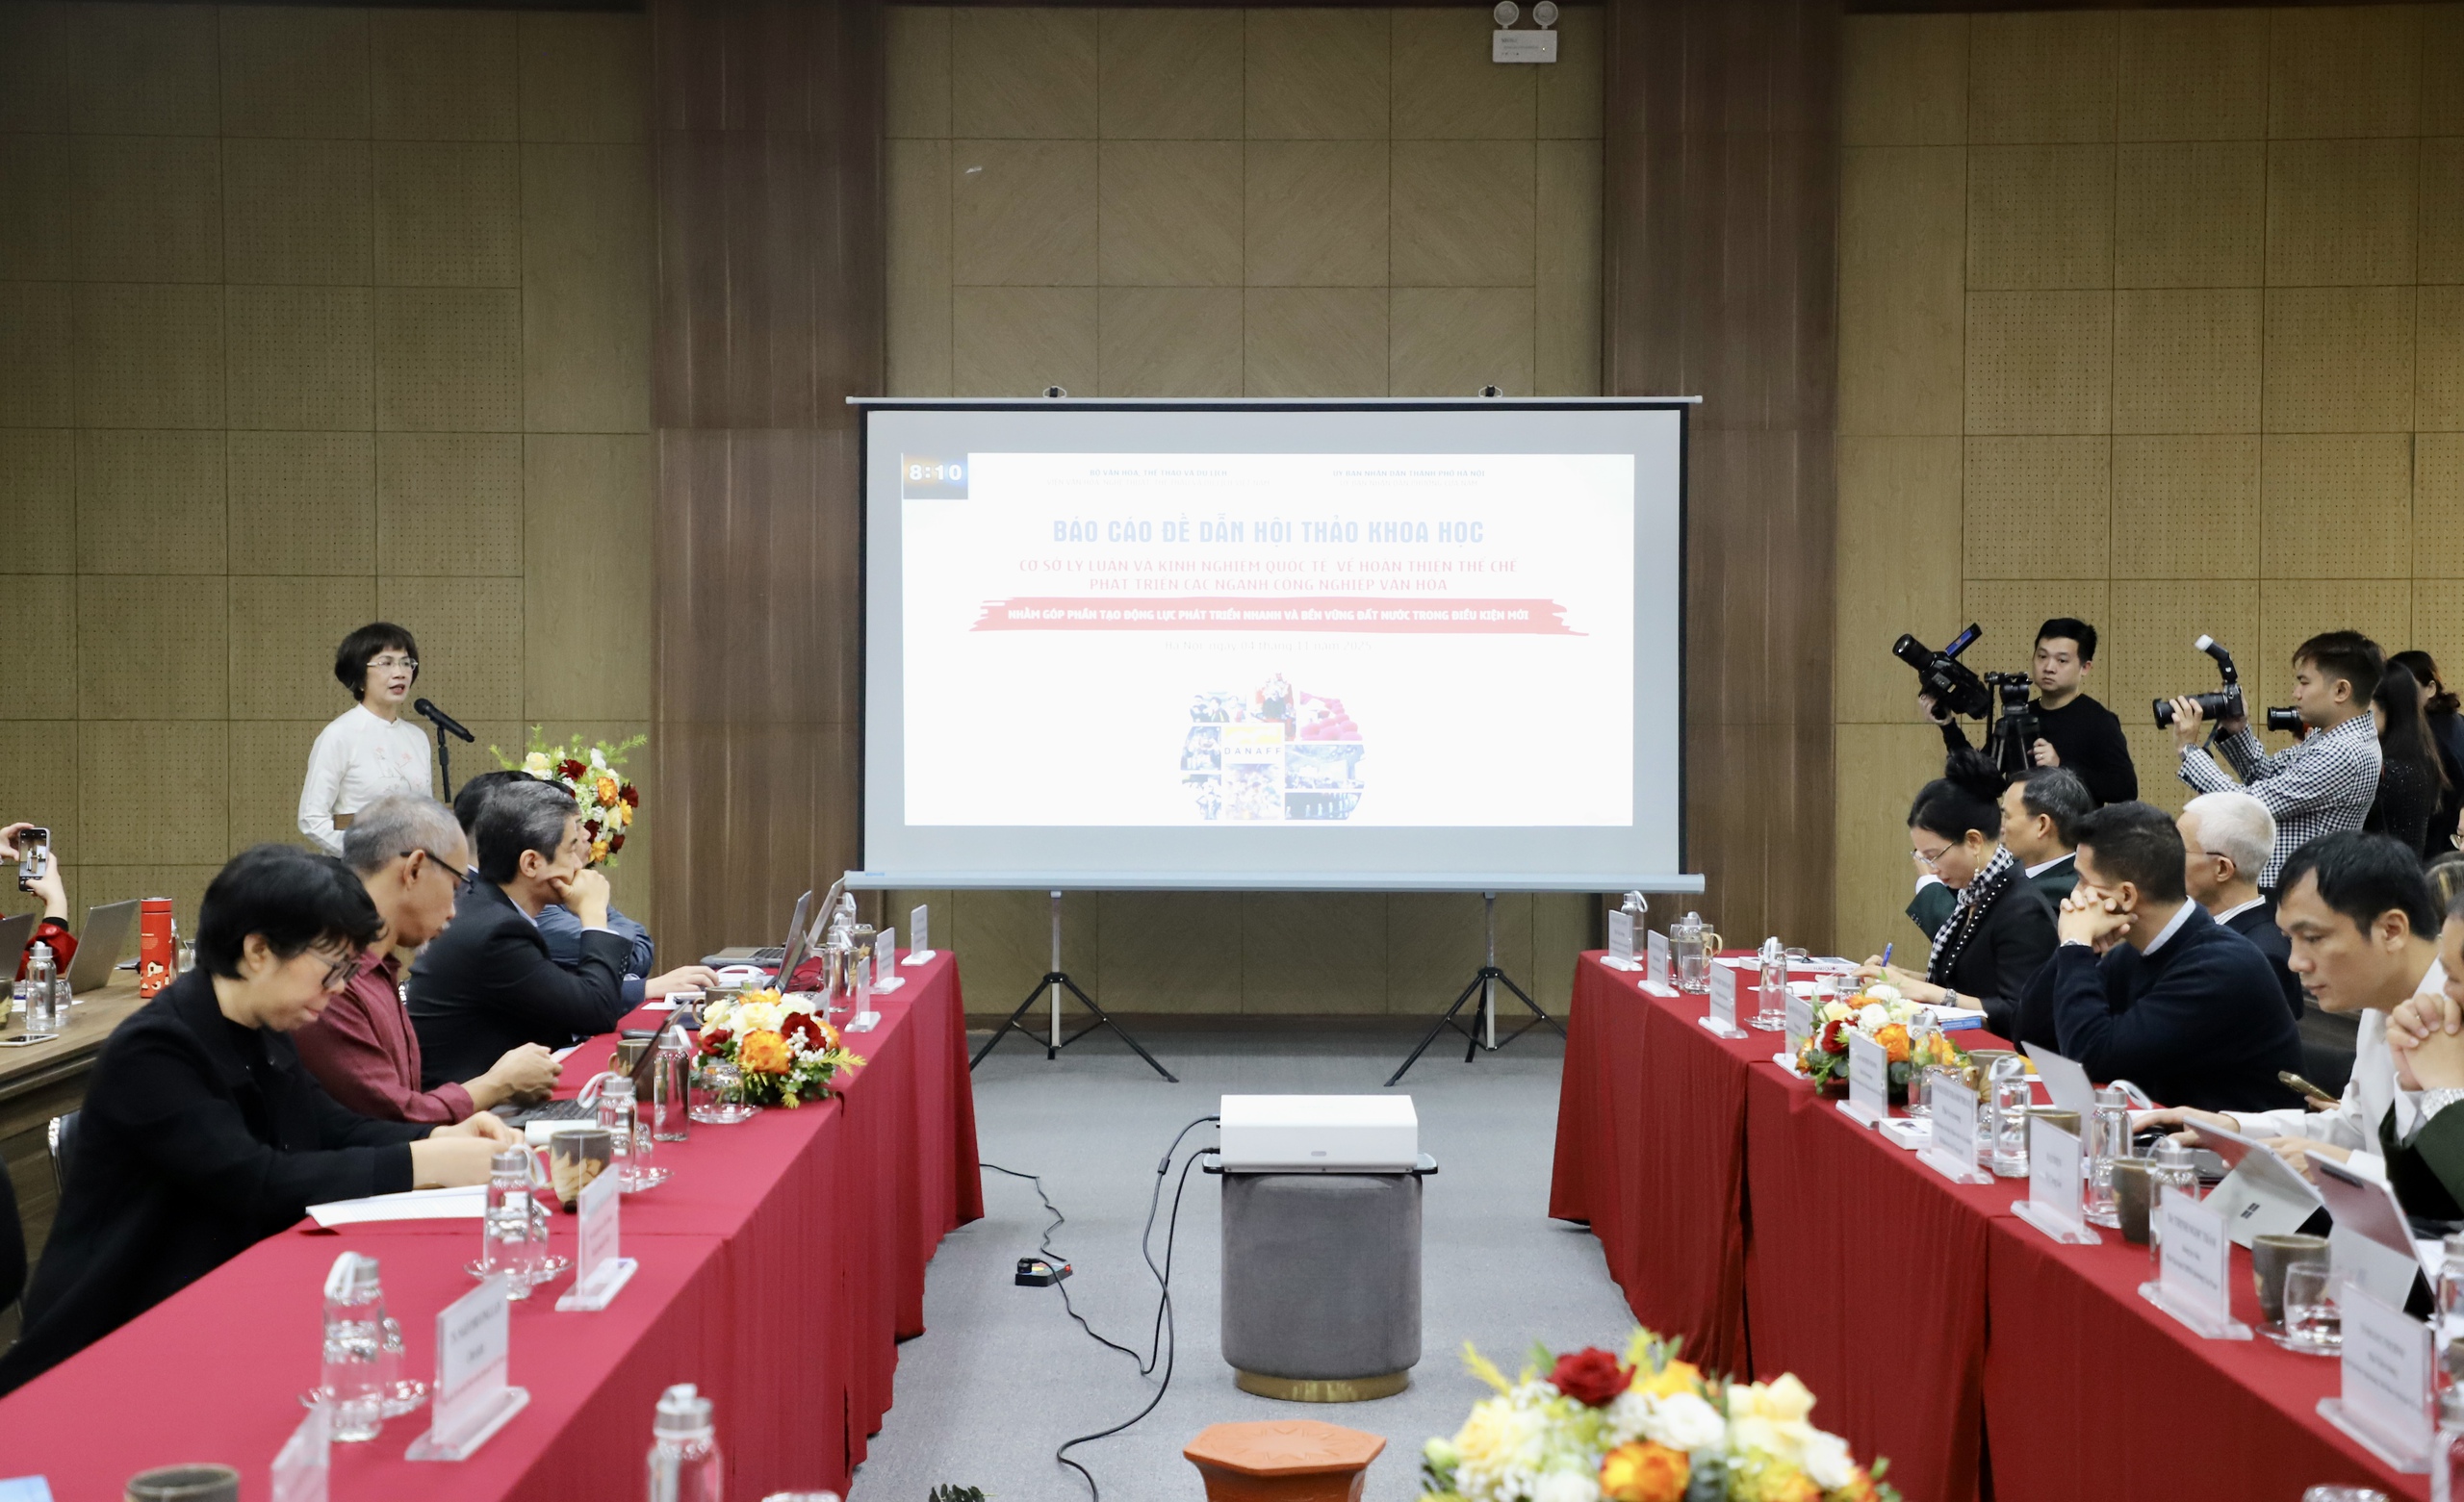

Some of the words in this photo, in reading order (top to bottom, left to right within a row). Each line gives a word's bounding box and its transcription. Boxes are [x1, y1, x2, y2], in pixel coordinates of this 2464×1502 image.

[909, 464, 962, 483] 8:10
[1346, 469, 1362, 477] BAN
[1054, 517, 1098, 543] BÁO
[1108, 517, 1152, 543] CÁO
[1162, 513, 1191, 543] ĐỀ
[1199, 514, 1244, 543] DẪN
[1254, 517, 1292, 547] HỘI
[1301, 515, 1359, 543] THẢO
[1369, 521, 1429, 543] KHOA
[1438, 521, 1484, 547] HỌC
[1019, 560, 1039, 573] CƠ
[1158, 560, 1195, 573] KINH
[1243, 610, 1282, 620] NHANH
[1412, 610, 1450, 620] TRONG
[1241, 640, 1255, 649] 04
[1296, 640, 1309, 649] 11
[1343, 640, 1372, 649] 2025
[1223, 747, 1281, 755] DANAFF
